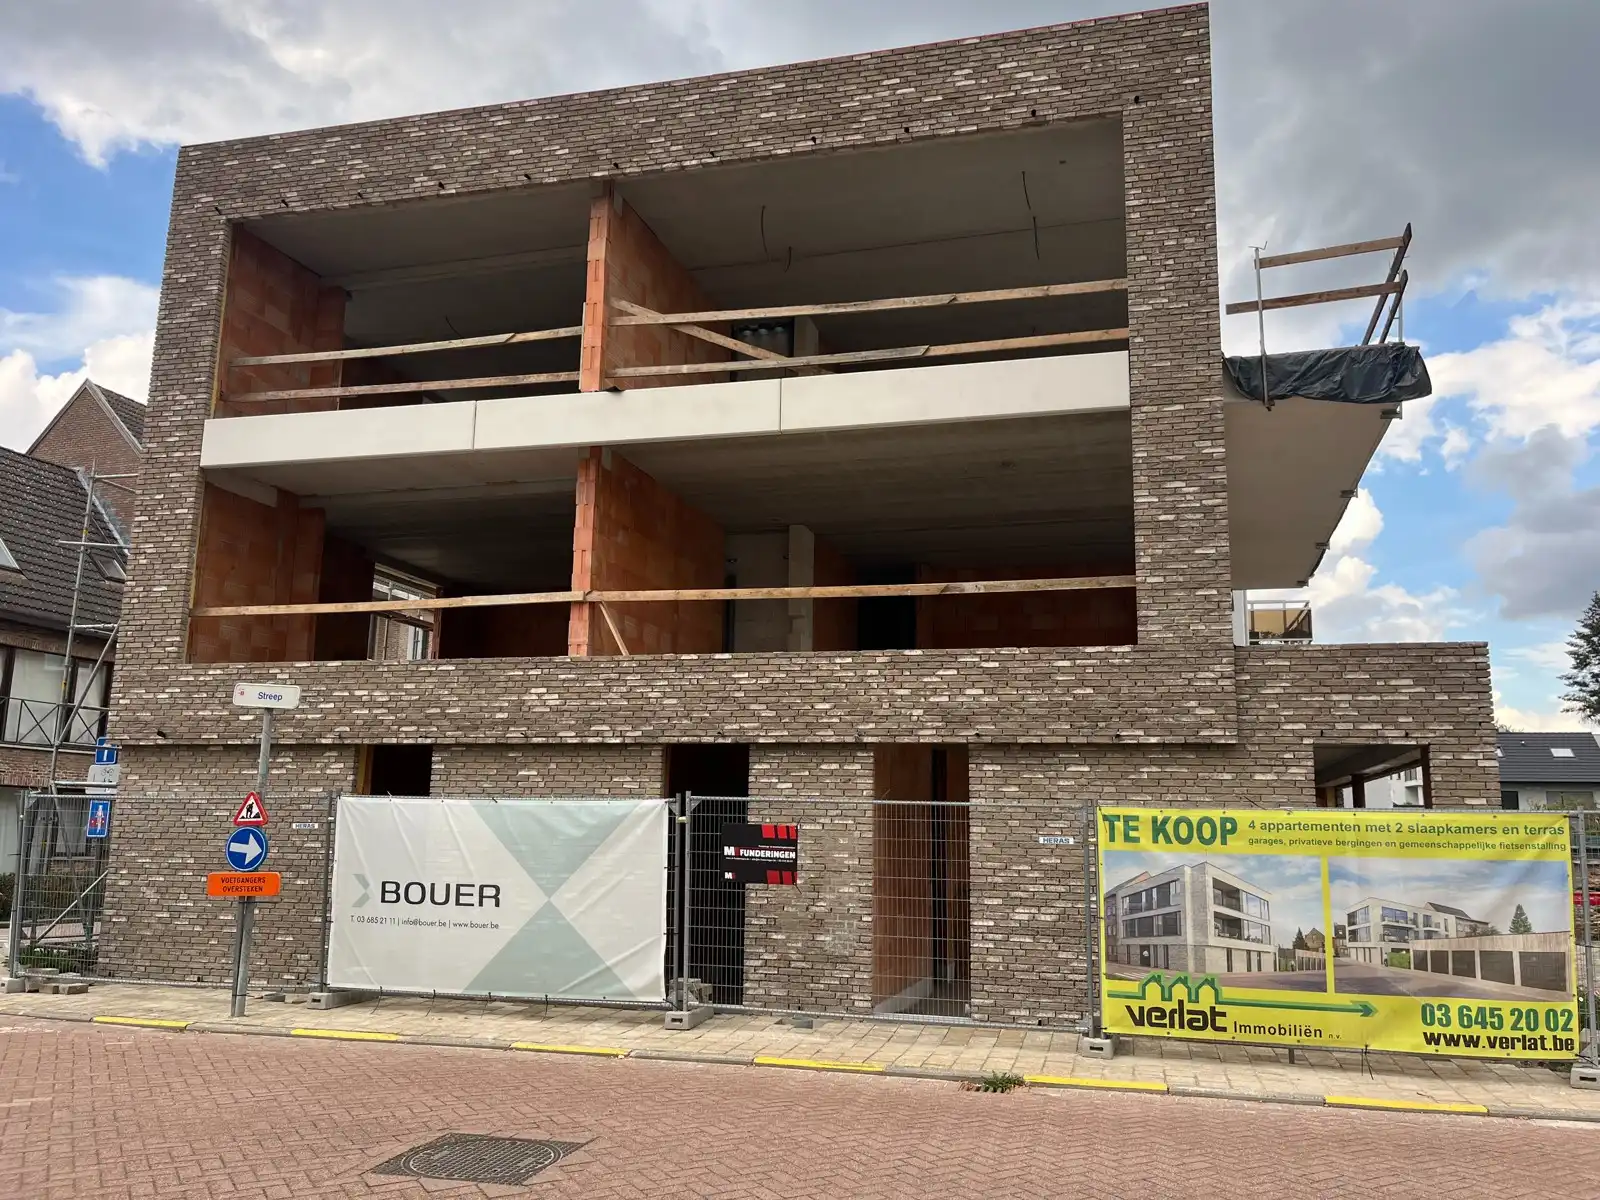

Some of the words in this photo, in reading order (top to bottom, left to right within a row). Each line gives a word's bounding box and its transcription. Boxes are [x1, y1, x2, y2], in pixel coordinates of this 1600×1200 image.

[258, 691, 283, 702] Streep
[1103, 815, 1140, 843] TE
[1151, 815, 1238, 846] KOOP
[1248, 819, 1256, 830] 4
[1260, 820, 1361, 833] appartementen
[1365, 823, 1391, 834] met
[1395, 822, 1404, 833] 2
[1407, 825, 1498, 837] slaapkamers
[1502, 826, 1519, 836] en
[1523, 826, 1565, 836] terras
[1248, 837, 1286, 846] garages,
[1289, 836, 1333, 847] privatieve
[1335, 838, 1382, 849] bergingen
[1399, 840, 1497, 851] gemeenschappelijke
[1499, 841, 1566, 852] fietsenstalling
[740, 849, 795, 859] FUNDERINGEN
[220, 876, 266, 884] VOETGANGERS
[222, 885, 263, 893] OVERSTEKEN
[381, 881, 500, 907] BOUER
[379, 917, 388, 925] 21
[401, 917, 447, 928] info@bouer.be
[452, 921, 500, 929] www.bouer.be
[1125, 999, 1228, 1033] verlat
[1233, 1021, 1323, 1038] Immobiliën
[1421, 1003, 1451, 1027] 03
[1457, 1005, 1504, 1031] 645
[1509, 1008, 1539, 1032] 20
[1544, 1008, 1573, 1032] 02
[1423, 1032, 1575, 1052] www.verlat.be
